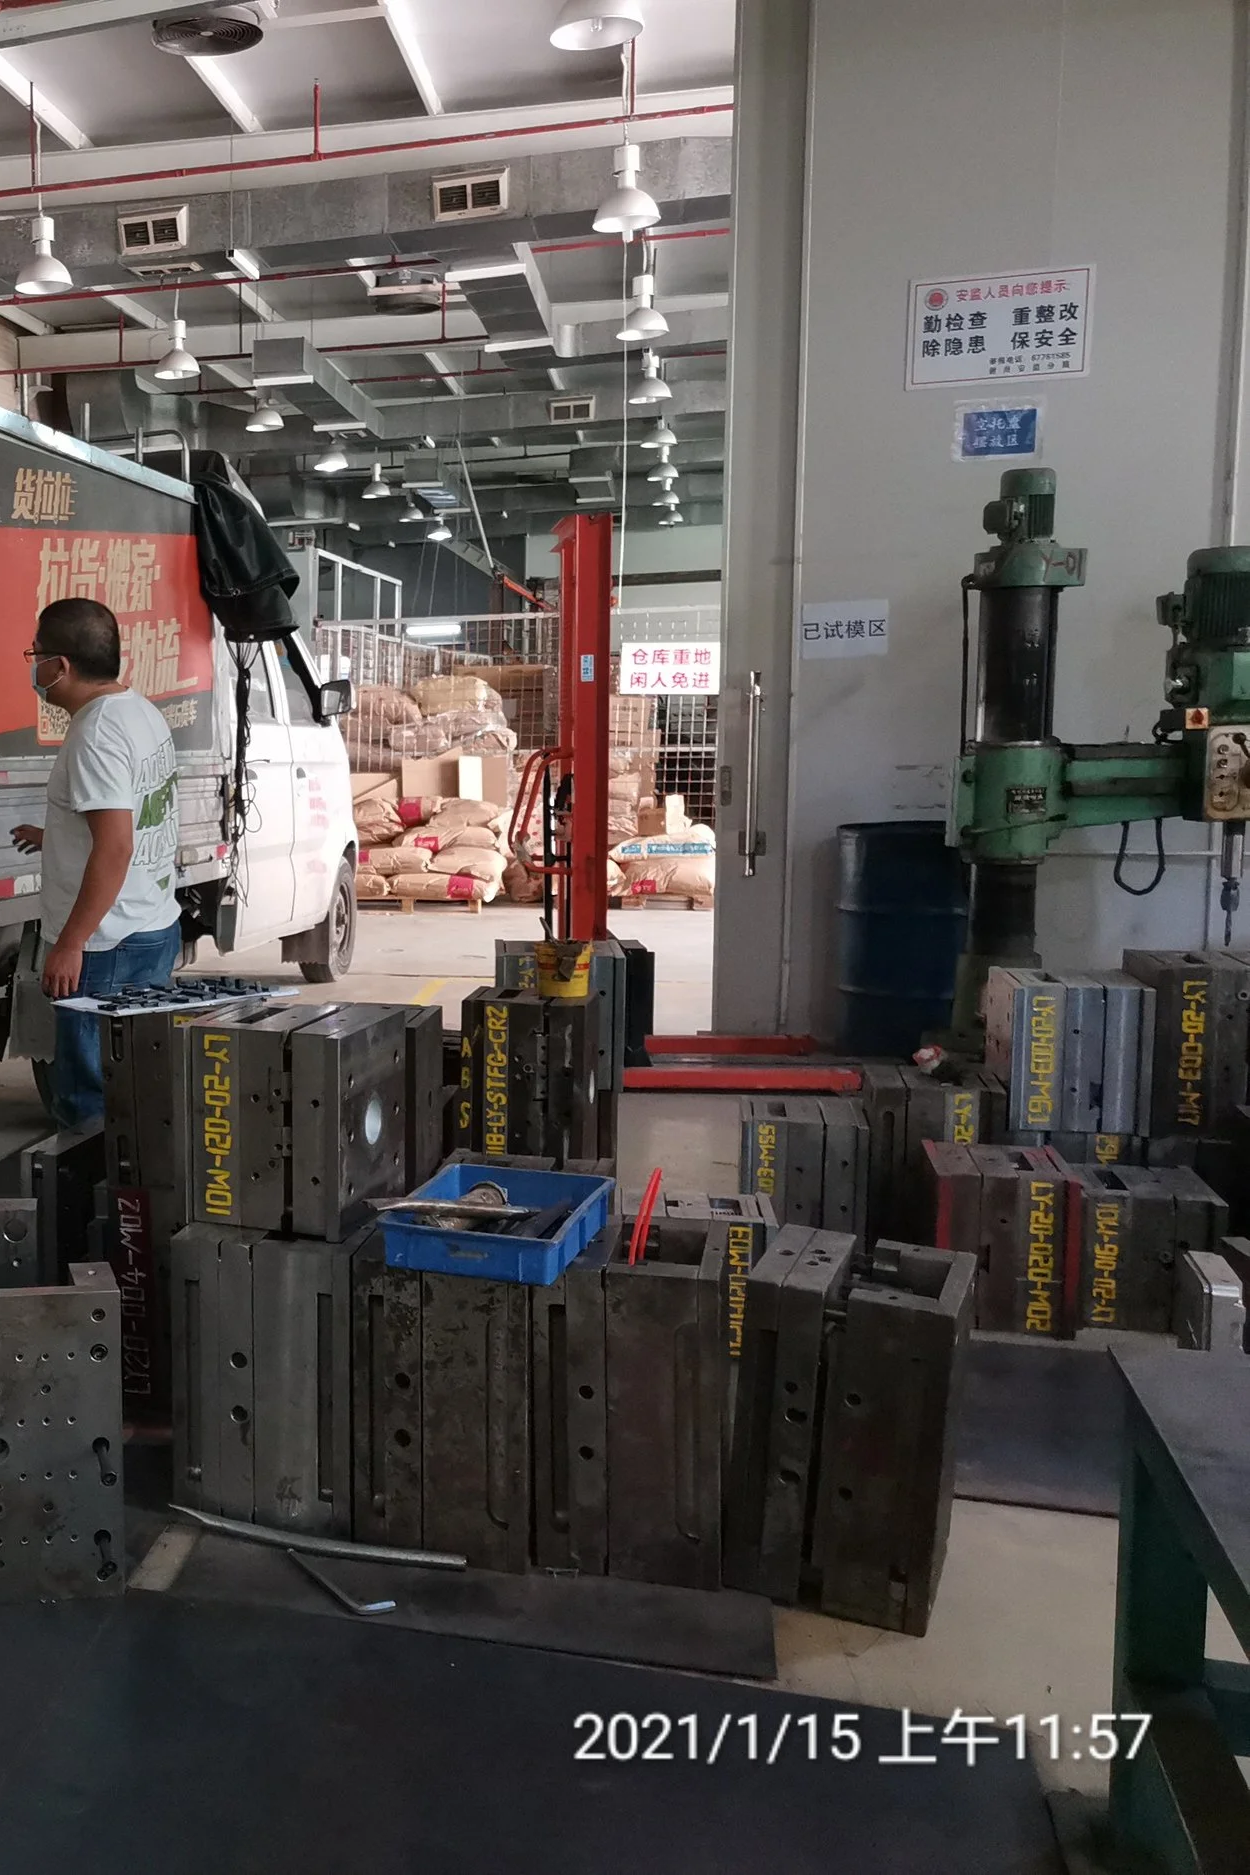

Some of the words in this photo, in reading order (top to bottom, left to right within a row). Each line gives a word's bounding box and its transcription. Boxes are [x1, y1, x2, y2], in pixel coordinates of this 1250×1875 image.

[956, 279, 1068, 302] 安监人员向您提示
[923, 311, 988, 334] 勤检查
[1012, 302, 1079, 326] 重整改
[922, 335, 986, 358] 除隐患
[1010, 327, 1078, 350] 保安全
[11, 467, 78, 524] 货拉拉
[803, 618, 887, 641] 已试模区
[631, 647, 712, 666] 仓库重地
[630, 670, 711, 689] 闲人免进
